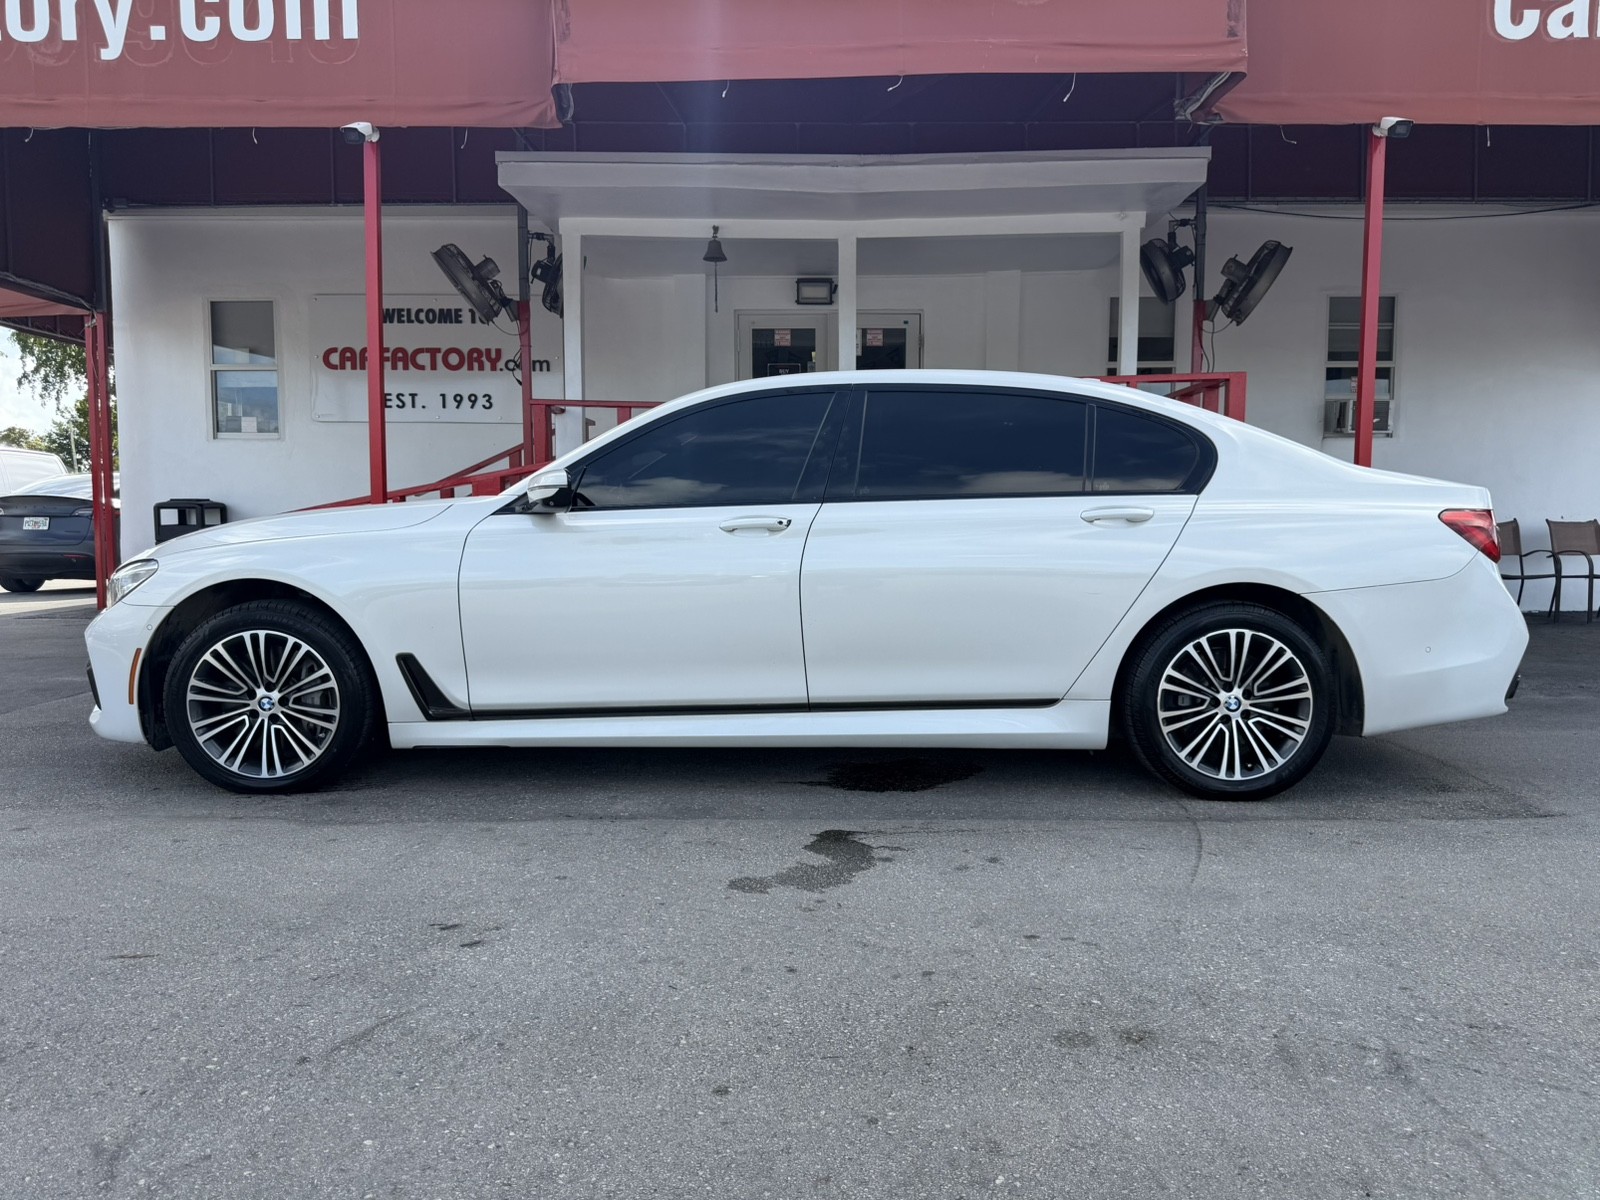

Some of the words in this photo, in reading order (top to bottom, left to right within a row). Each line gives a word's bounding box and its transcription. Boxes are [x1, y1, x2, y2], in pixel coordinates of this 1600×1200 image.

[0, 0, 359, 61] ory.com
[1494, 0, 1600, 40] Ca
[382, 308, 463, 324] WELCOME
[384, 393, 426, 409] EST.
[440, 393, 493, 410] 1993
